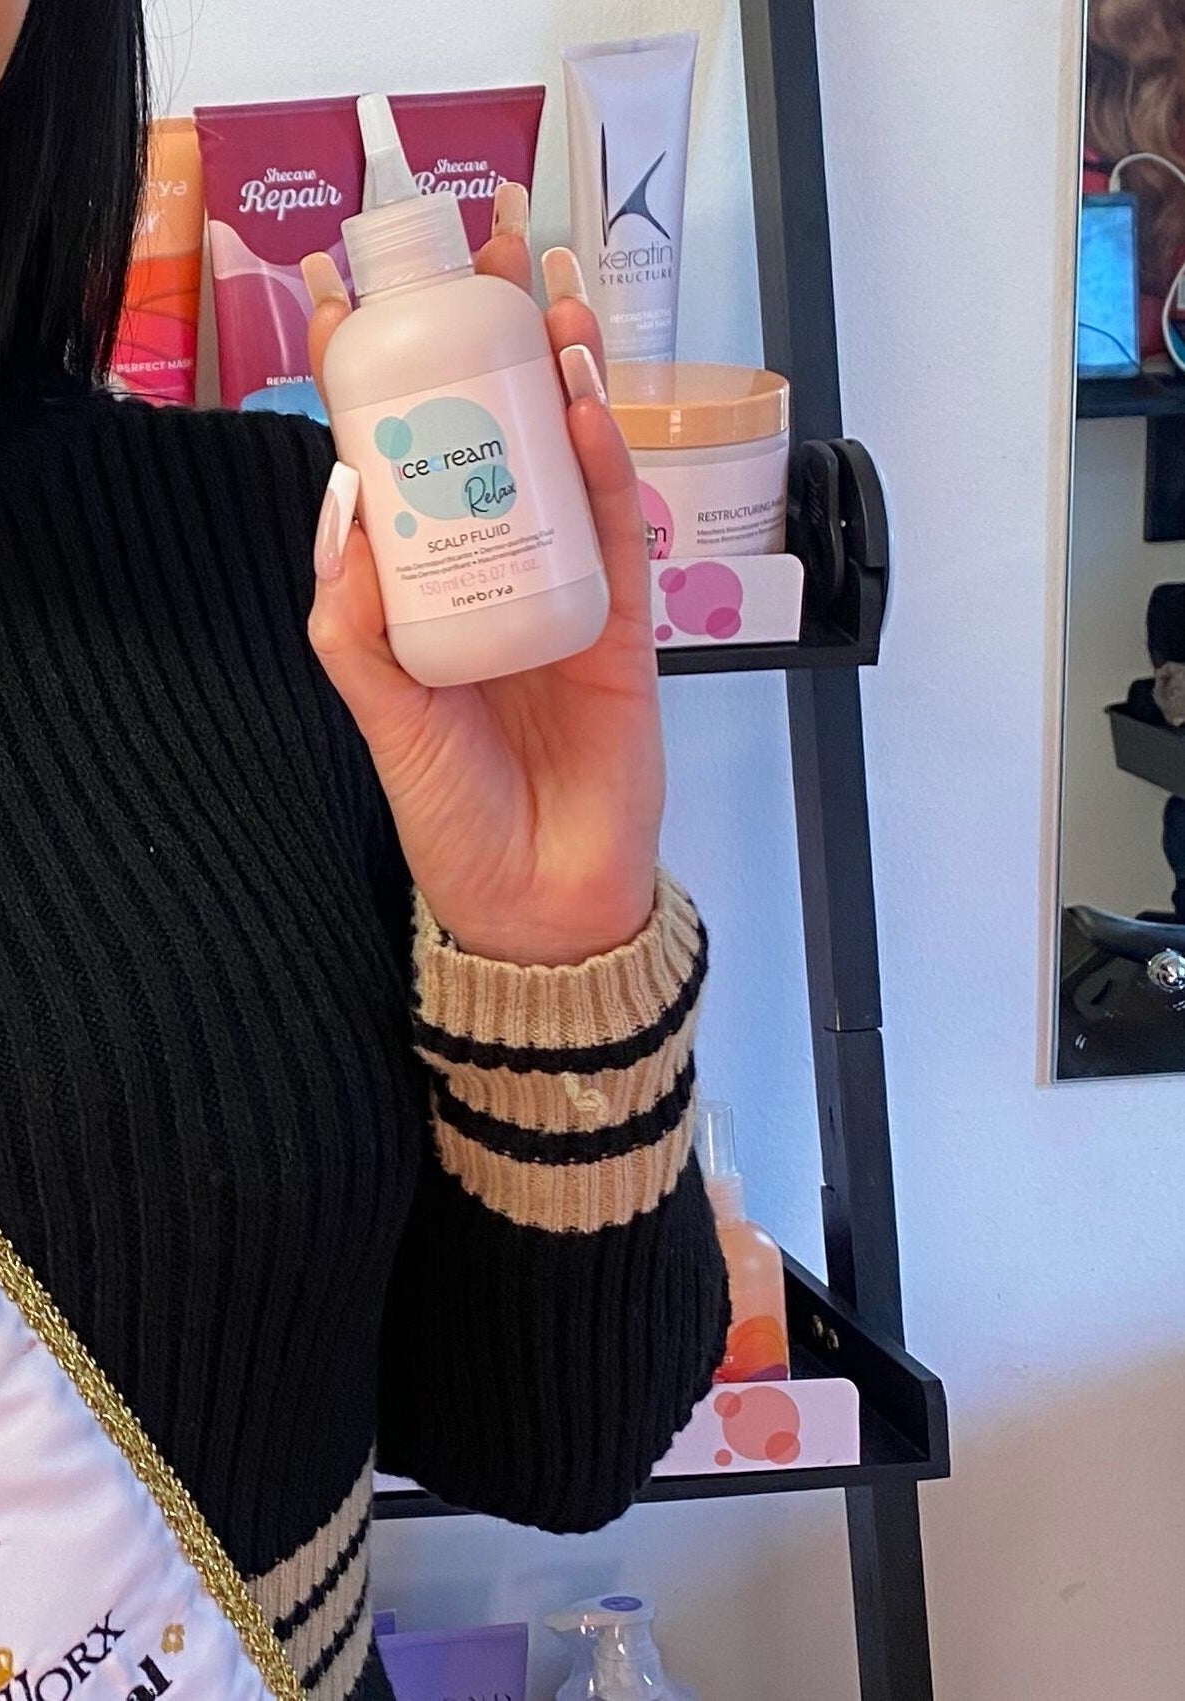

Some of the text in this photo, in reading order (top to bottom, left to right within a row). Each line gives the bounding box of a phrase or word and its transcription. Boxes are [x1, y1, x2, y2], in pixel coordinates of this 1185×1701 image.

[264, 168, 317, 183] Shecare
[434, 159, 488, 174] Shecare
[239, 179, 342, 221] Repair
[598, 241, 673, 270] keratin
[599, 267, 673, 286] STRUCTURE
[116, 361, 166, 373] PERFECT
[266, 375, 304, 386] REPAIR
[465, 466, 517, 518] Relax
[697, 501, 771, 522] RESTRUCTURING
[427, 523, 511, 553] SCALP FLUID
[419, 580, 441, 597] 150
[442, 576, 459, 593] ml
[477, 563, 506, 584] 5.07
